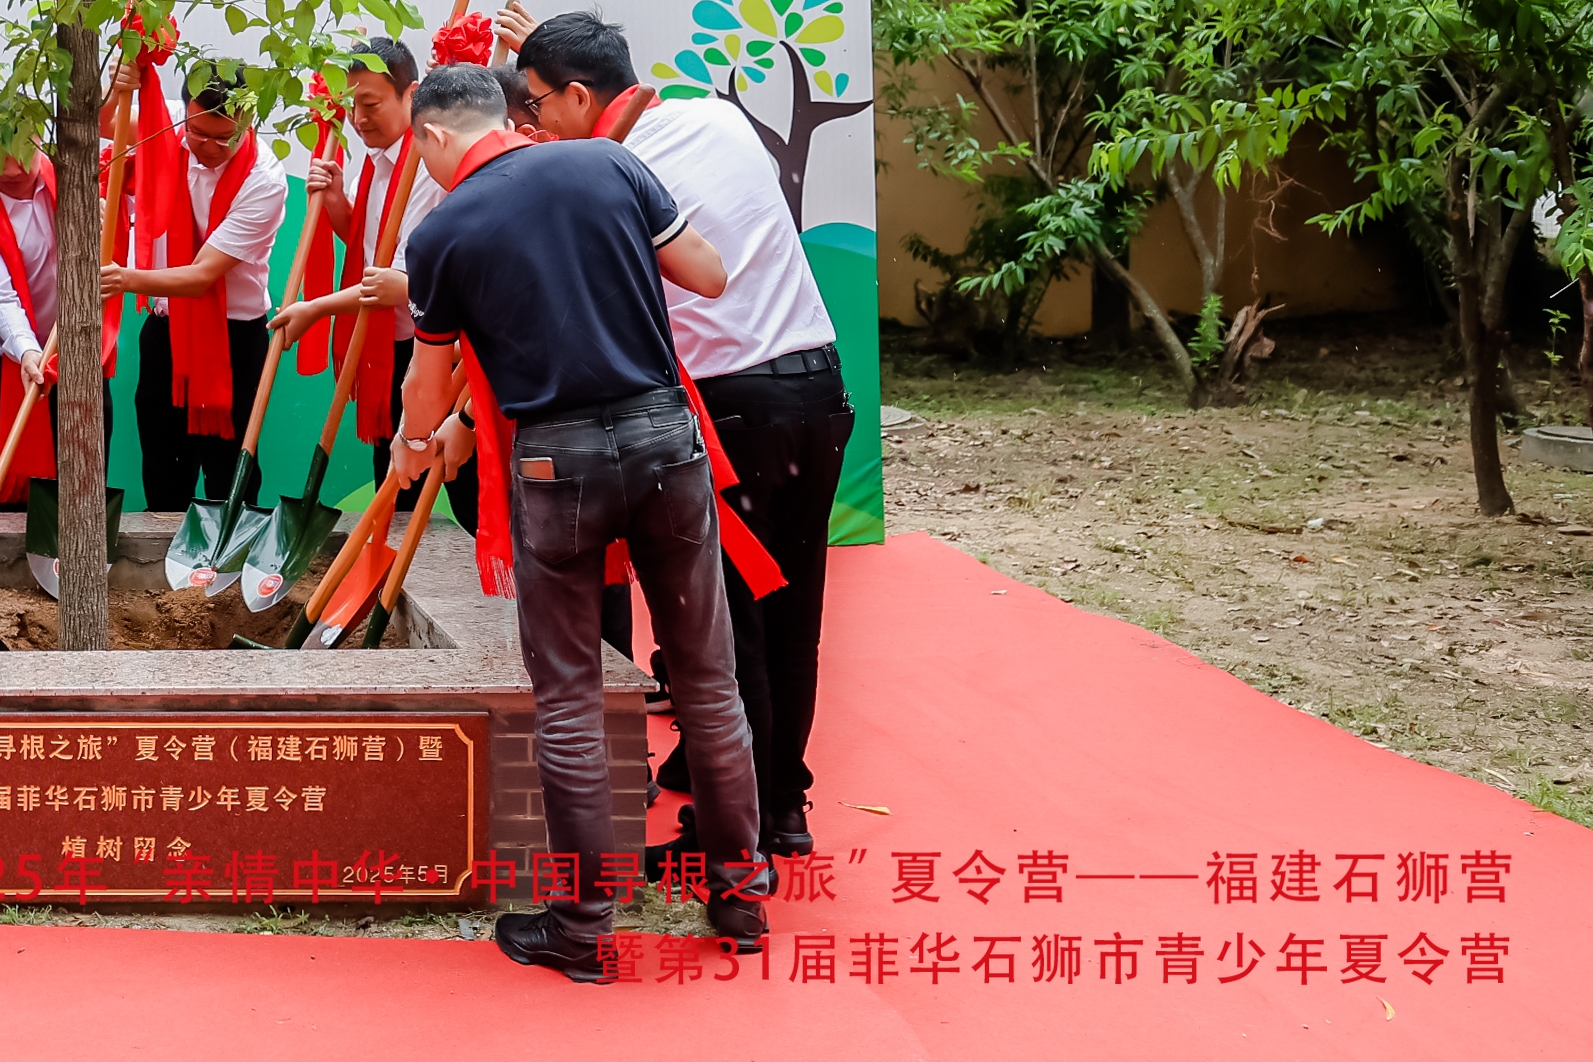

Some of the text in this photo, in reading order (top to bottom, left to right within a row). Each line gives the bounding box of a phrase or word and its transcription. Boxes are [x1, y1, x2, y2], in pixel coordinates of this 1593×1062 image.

[61, 835, 192, 862] 植树留念
[342, 864, 448, 884] 2025年5月
